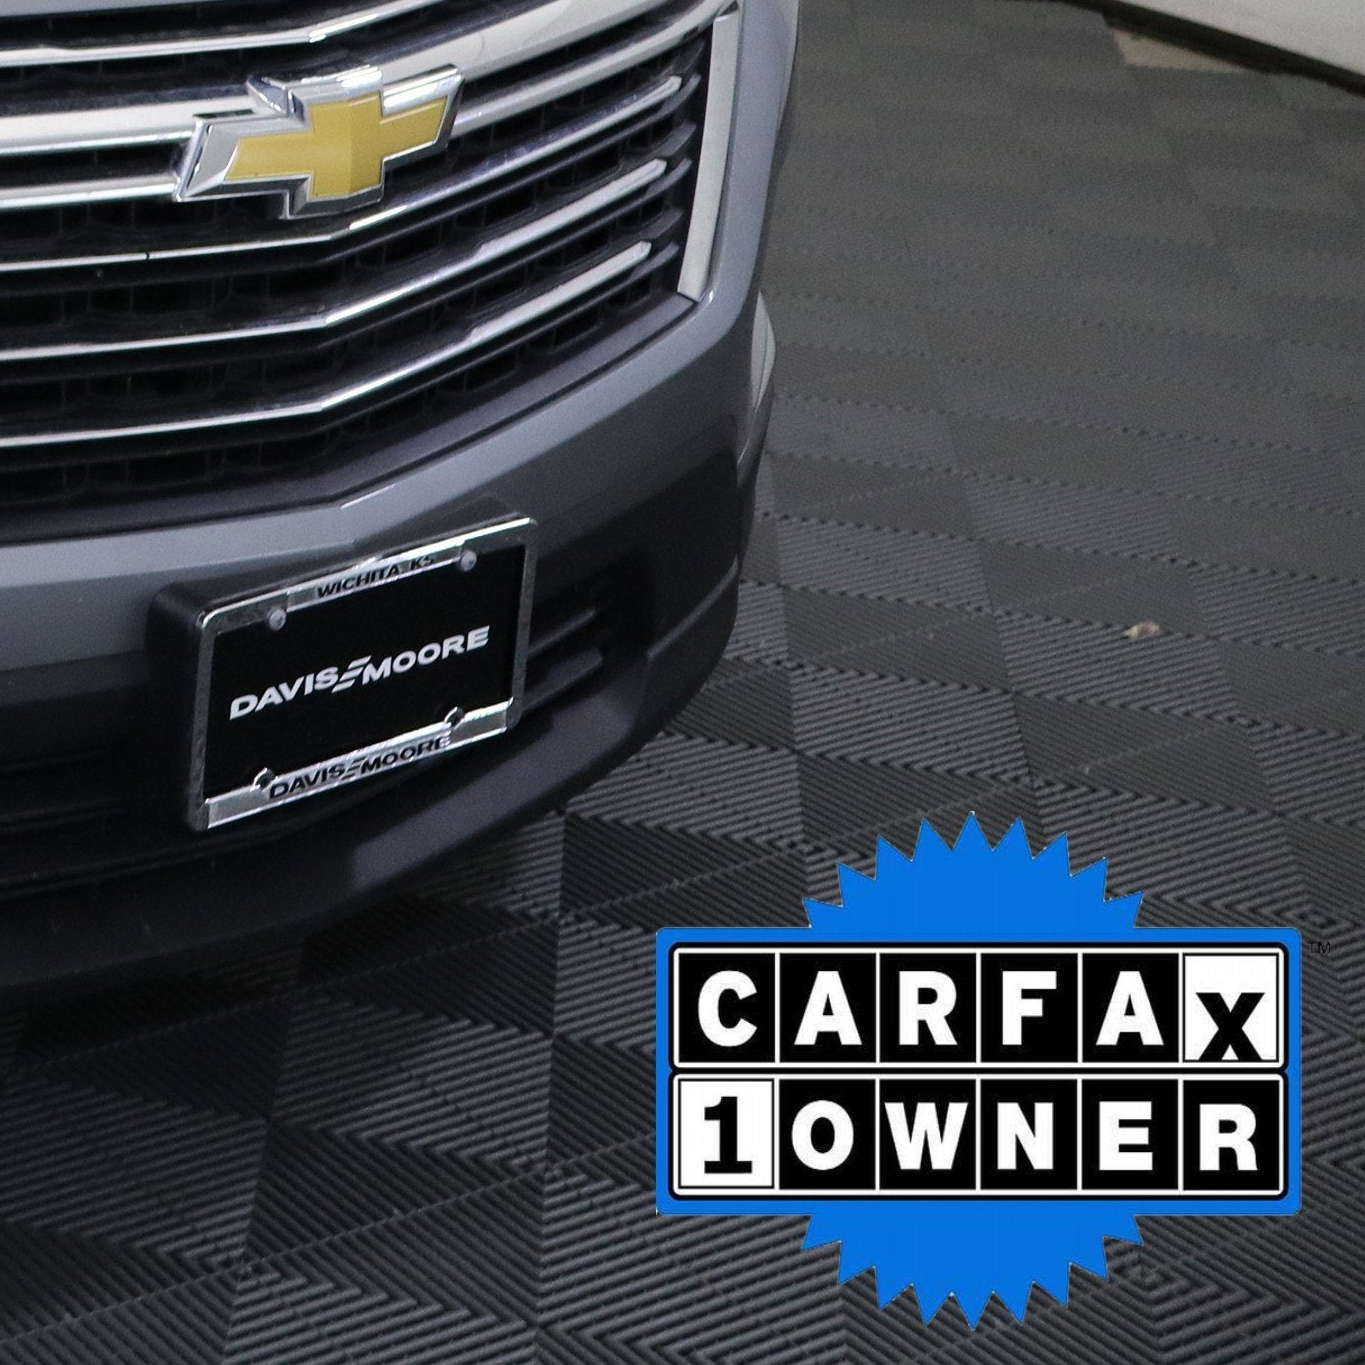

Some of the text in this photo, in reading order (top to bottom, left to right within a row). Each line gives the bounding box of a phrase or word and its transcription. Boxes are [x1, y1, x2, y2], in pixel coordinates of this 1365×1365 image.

[409, 555, 435, 571] KS
[230, 625, 491, 721] DAVIS MOORE
[269, 731, 452, 800] DAVIS MOORE
